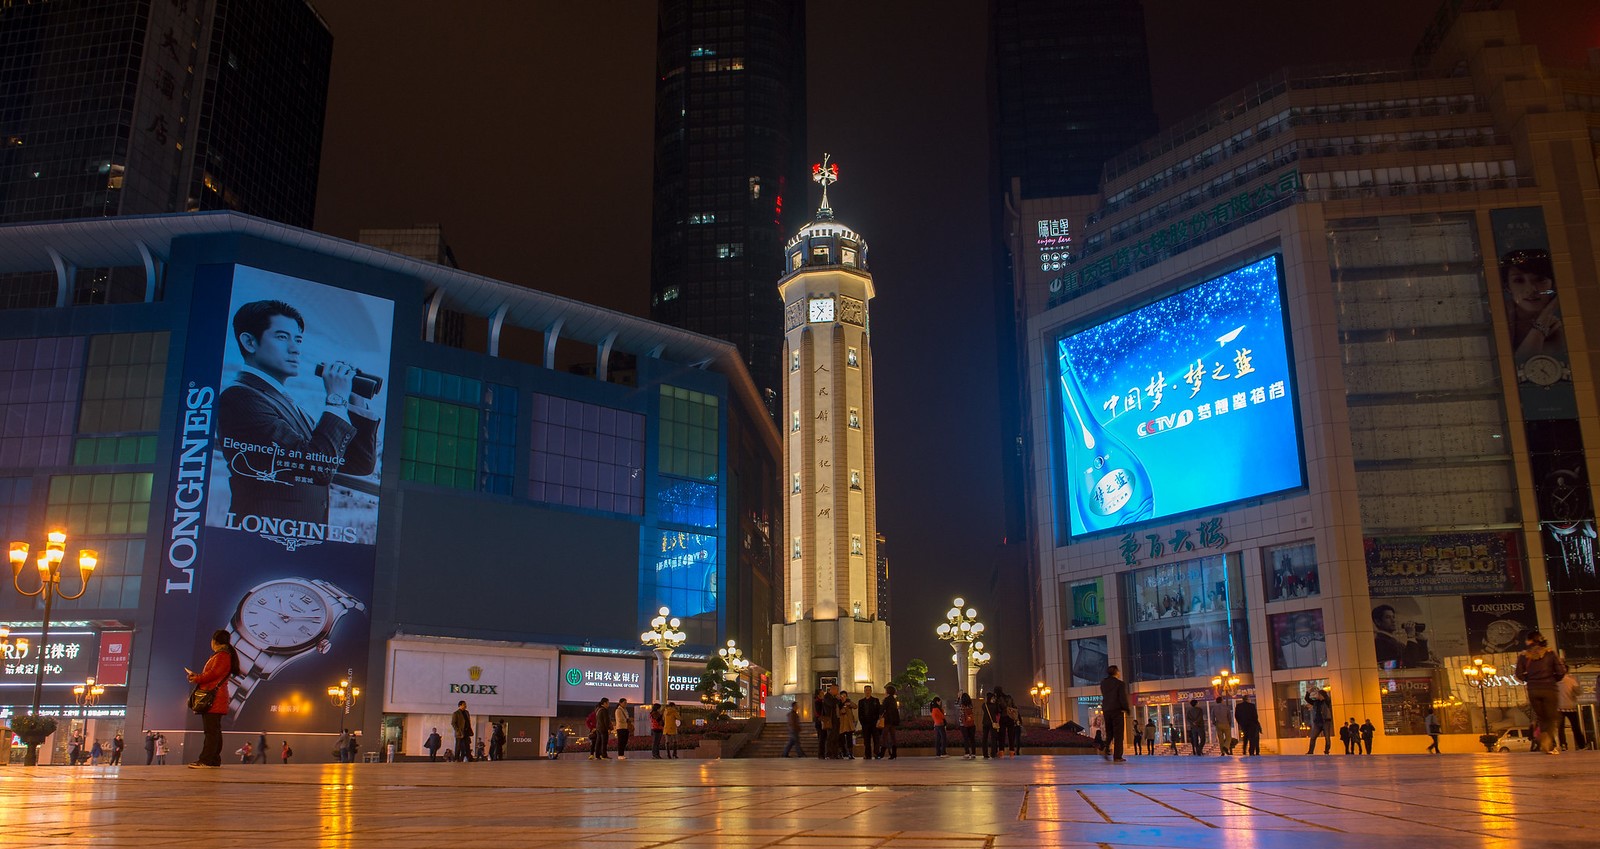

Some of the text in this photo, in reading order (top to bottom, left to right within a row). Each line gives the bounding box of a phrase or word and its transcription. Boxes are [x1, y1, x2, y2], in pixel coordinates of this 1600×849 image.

[223, 437, 346, 467] Elegance is an attitude
[165, 386, 215, 595] LONGINES
[225, 512, 357, 544] LONGINES
[1471, 602, 1526, 613] LONGINES
[585, 670, 640, 683] 中国农业银行
[450, 683, 498, 695] ROLEX
[669, 683, 698, 691] COFFE
